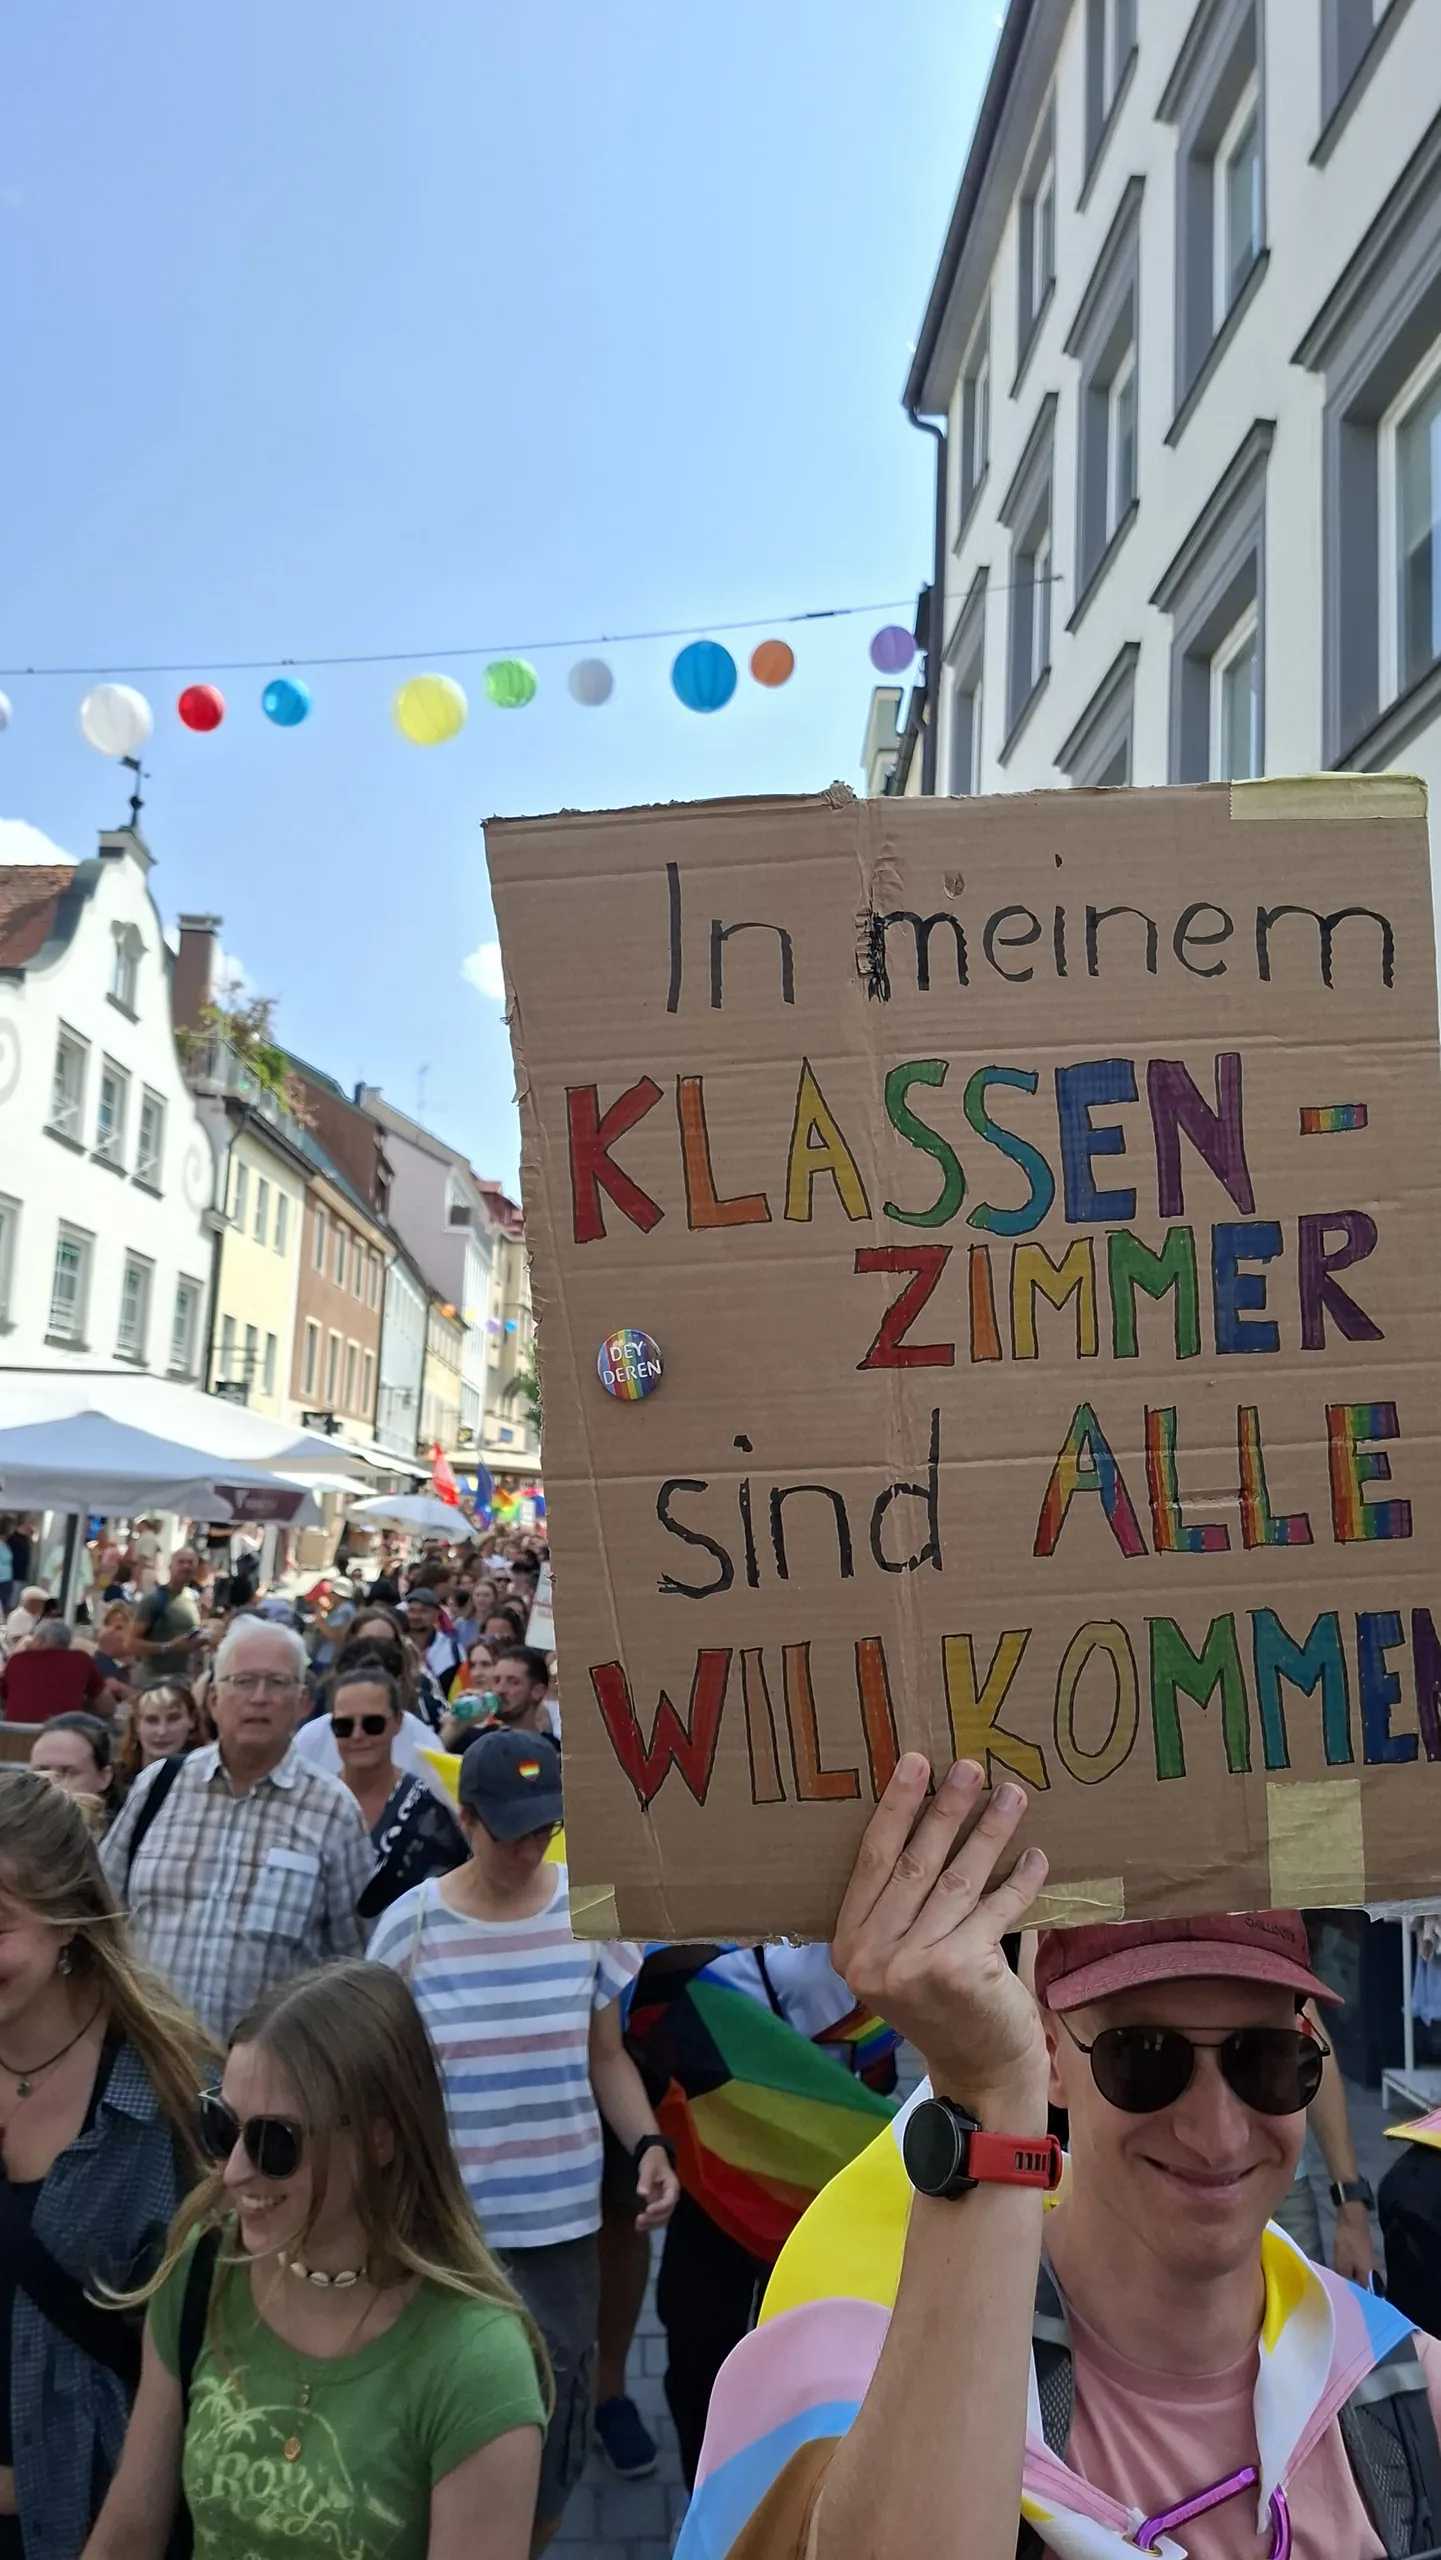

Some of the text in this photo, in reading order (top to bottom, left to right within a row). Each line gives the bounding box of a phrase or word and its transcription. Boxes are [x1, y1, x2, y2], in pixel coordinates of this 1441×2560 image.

[665, 853, 1395, 1014] In meinem
[609, 1340, 644, 1362] DEY
[854, 1208, 1386, 1370] ZIMMER
[603, 1359, 662, 1386] DEREN
[656, 1401, 1413, 1600] sind ALLE
